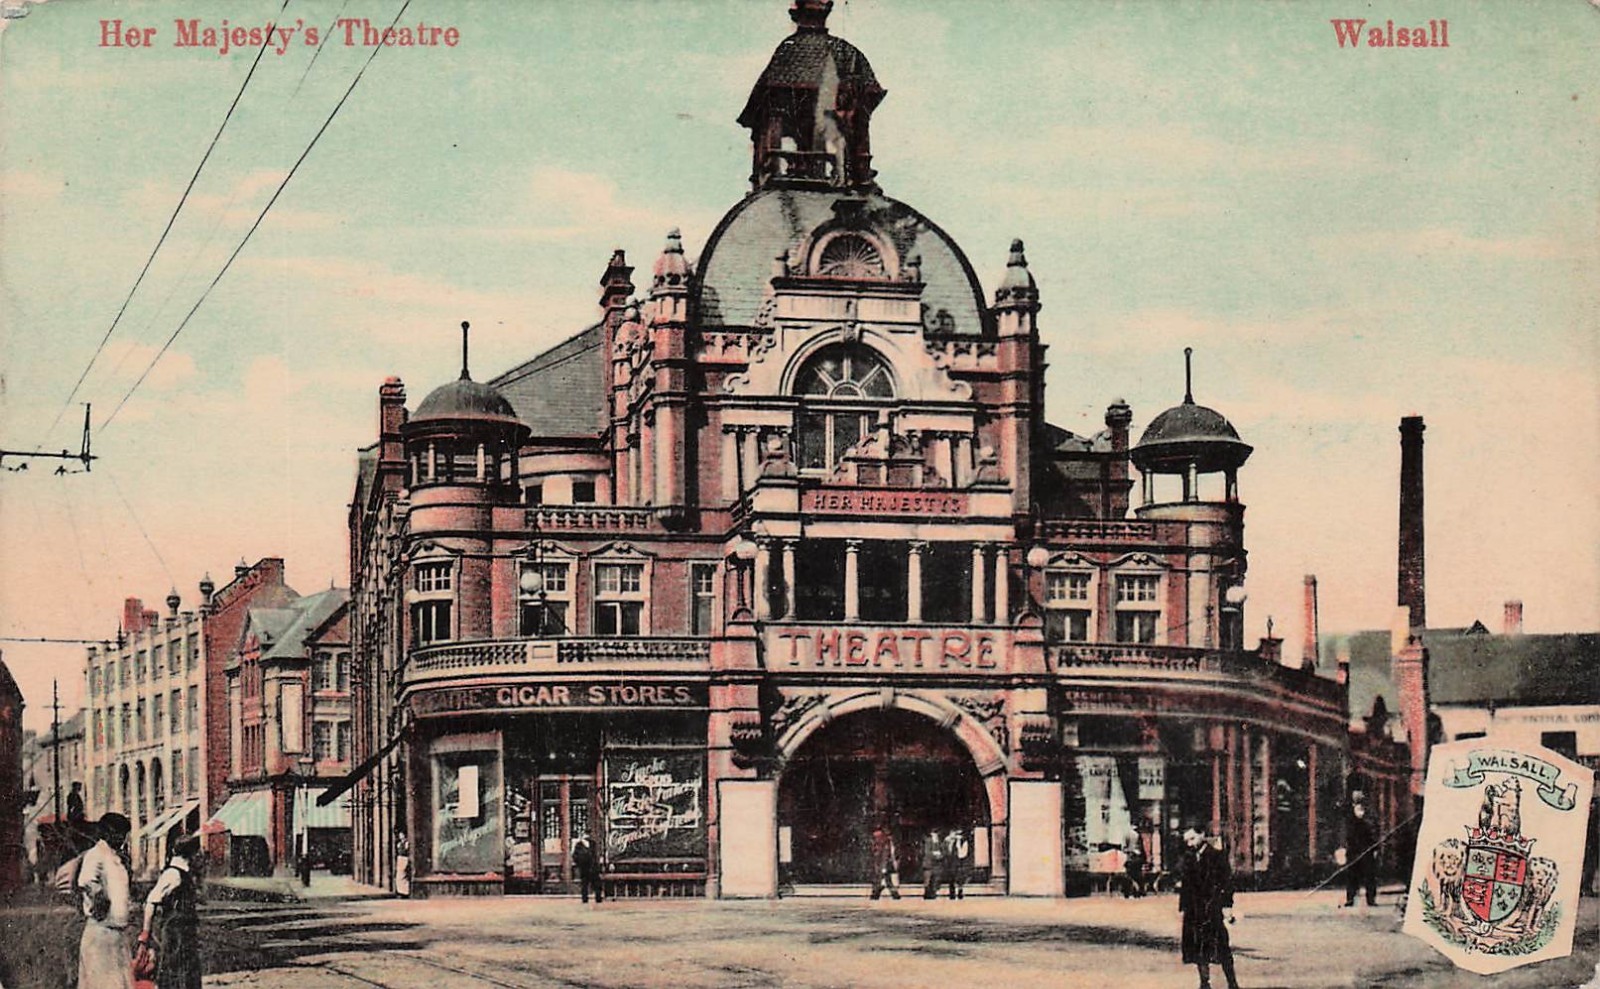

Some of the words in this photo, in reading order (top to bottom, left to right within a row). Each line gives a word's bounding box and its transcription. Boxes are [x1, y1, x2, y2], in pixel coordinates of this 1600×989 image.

[814, 494, 853, 511] HER
[778, 628, 998, 668] THEATRE
[496, 685, 570, 707] CIGAR
